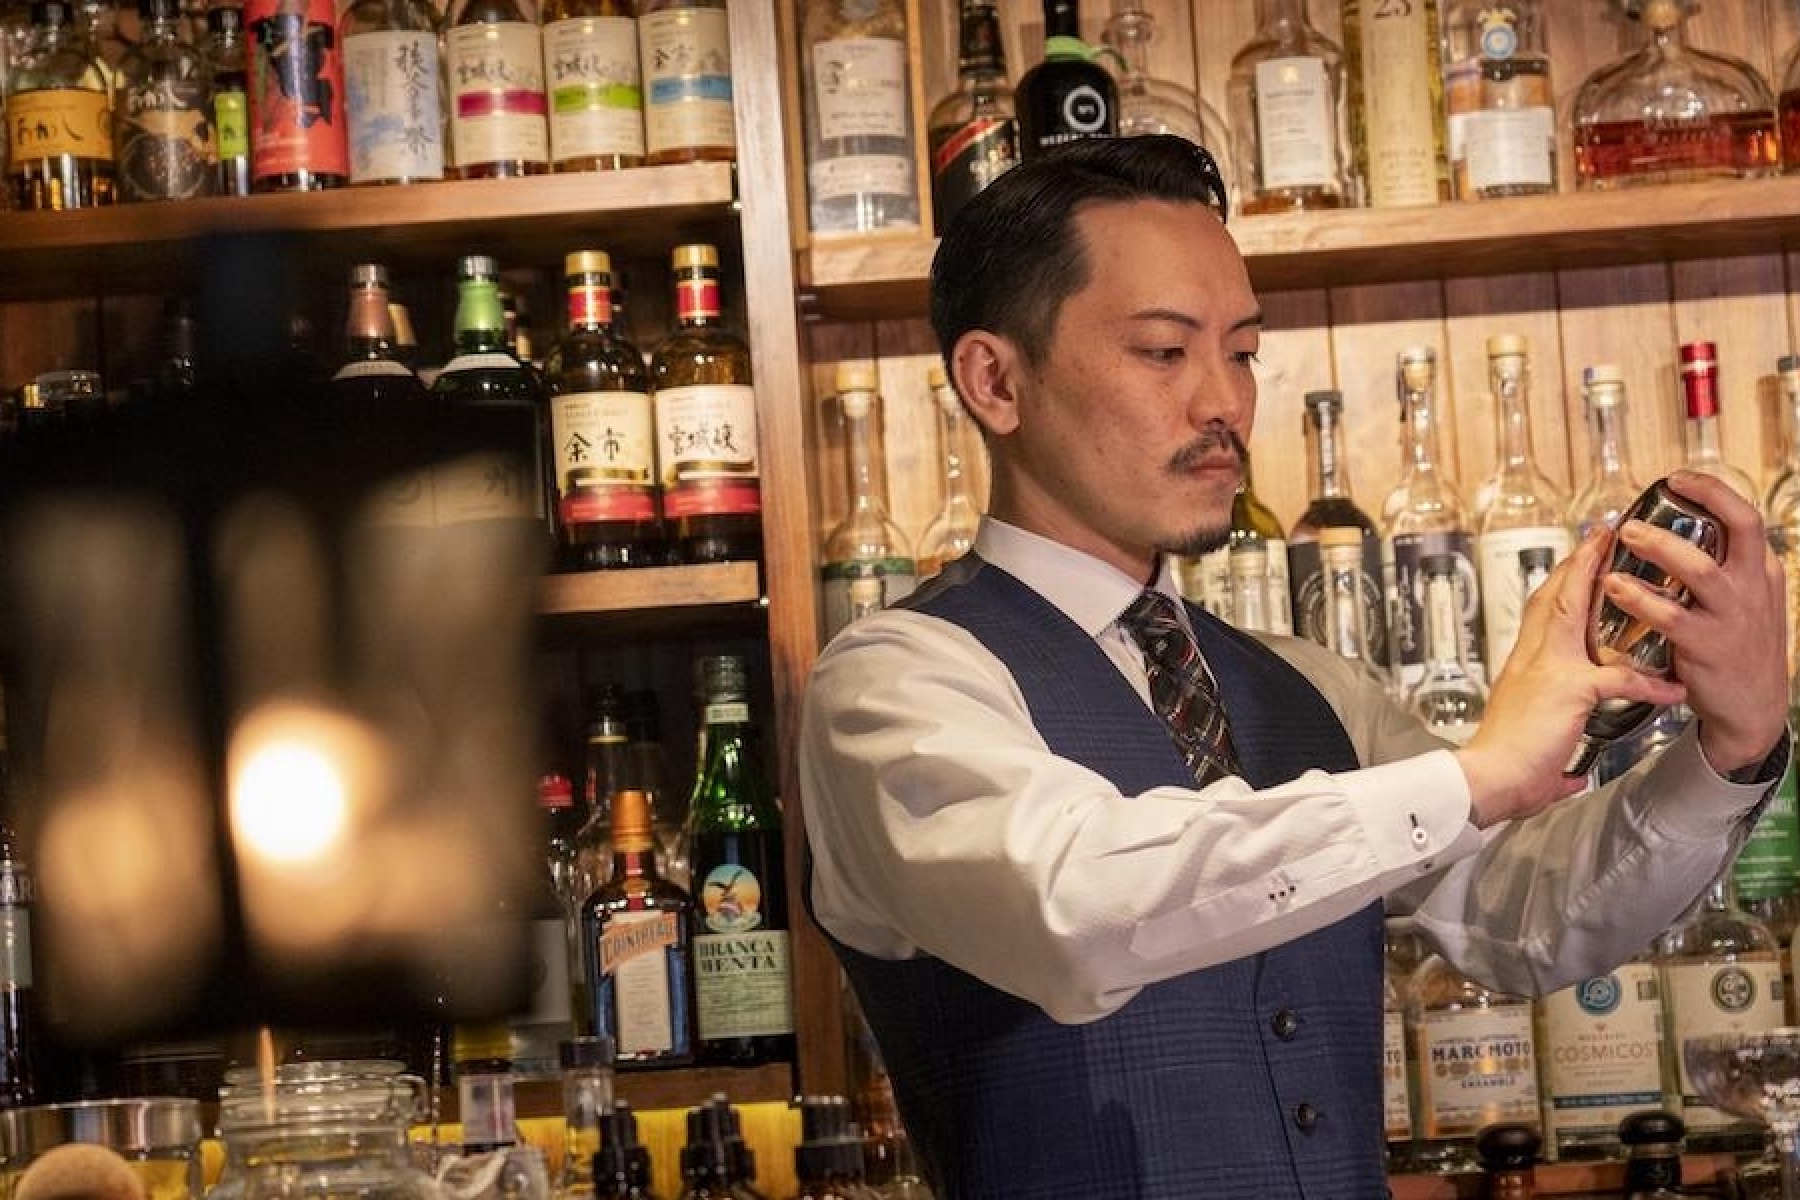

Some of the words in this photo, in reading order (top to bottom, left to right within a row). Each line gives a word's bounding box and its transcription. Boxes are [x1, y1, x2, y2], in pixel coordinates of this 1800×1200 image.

[563, 427, 627, 463] 余市
[699, 940, 776, 957] BRANCA
[700, 955, 777, 973] MENTA
[1554, 1039, 1655, 1063] COSMICOS
